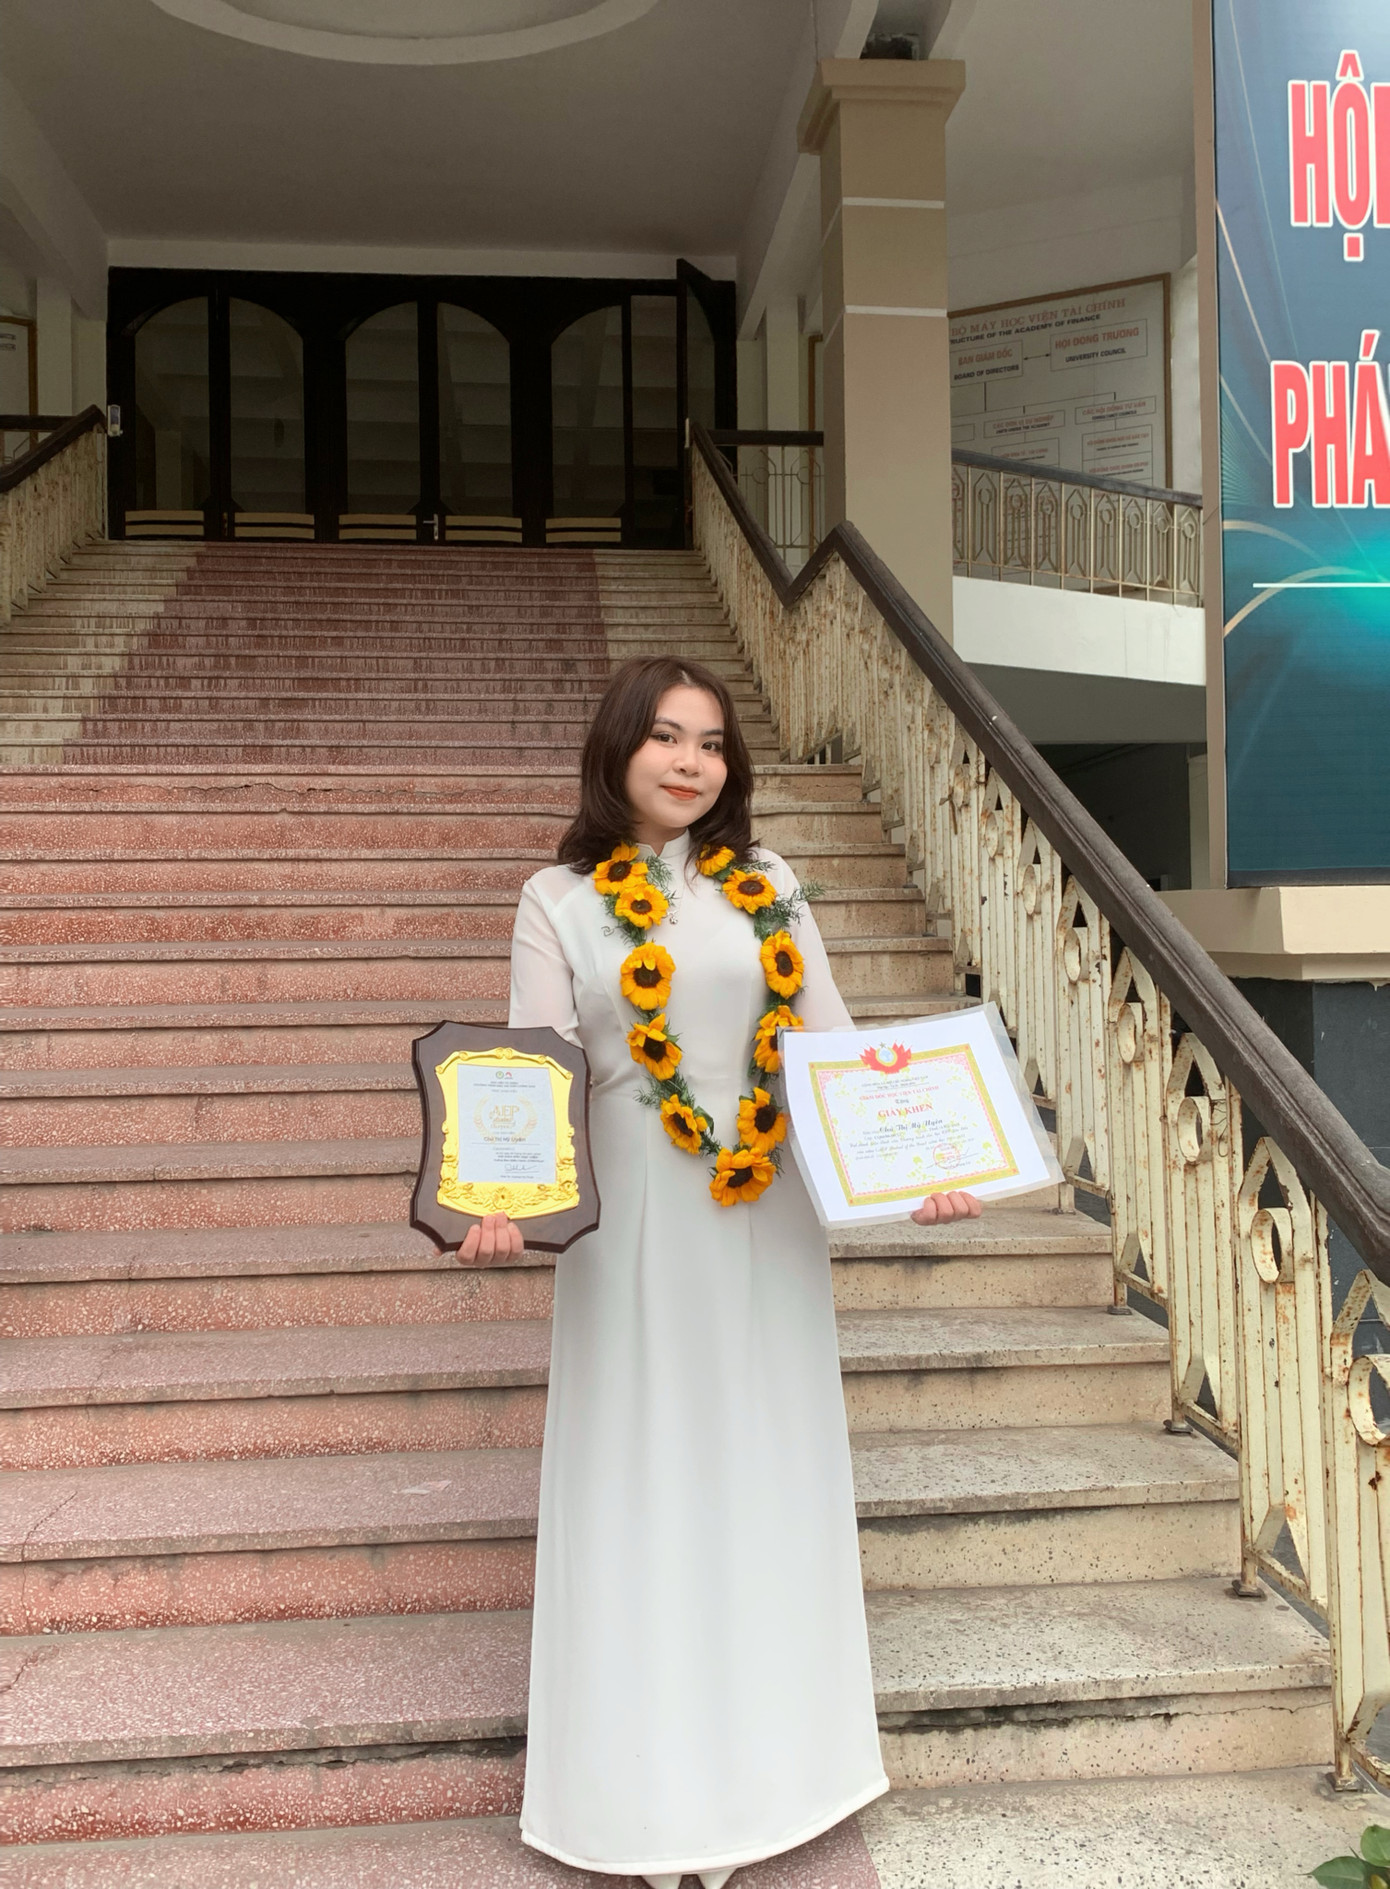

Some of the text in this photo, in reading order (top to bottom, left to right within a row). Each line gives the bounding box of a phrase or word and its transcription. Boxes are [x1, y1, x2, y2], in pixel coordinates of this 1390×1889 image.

[1000, 316, 1025, 329] HỌC
[1028, 310, 1058, 324] VIỆN
[1086, 298, 1126, 313] CHÍNH
[999, 329, 1012, 337] THE
[1014, 322, 1052, 334] ACADEMY
[1055, 320, 1065, 328] OF
[1067, 314, 1101, 325] FINANCE
[1065, 347, 1127, 363] UNIVERSITY COUNCIL
[954, 364, 1019, 381] BOARD OF DIRECTORS
[1270, 329, 1390, 509] PHÁ
[905, 1102, 934, 1116] KHEN
